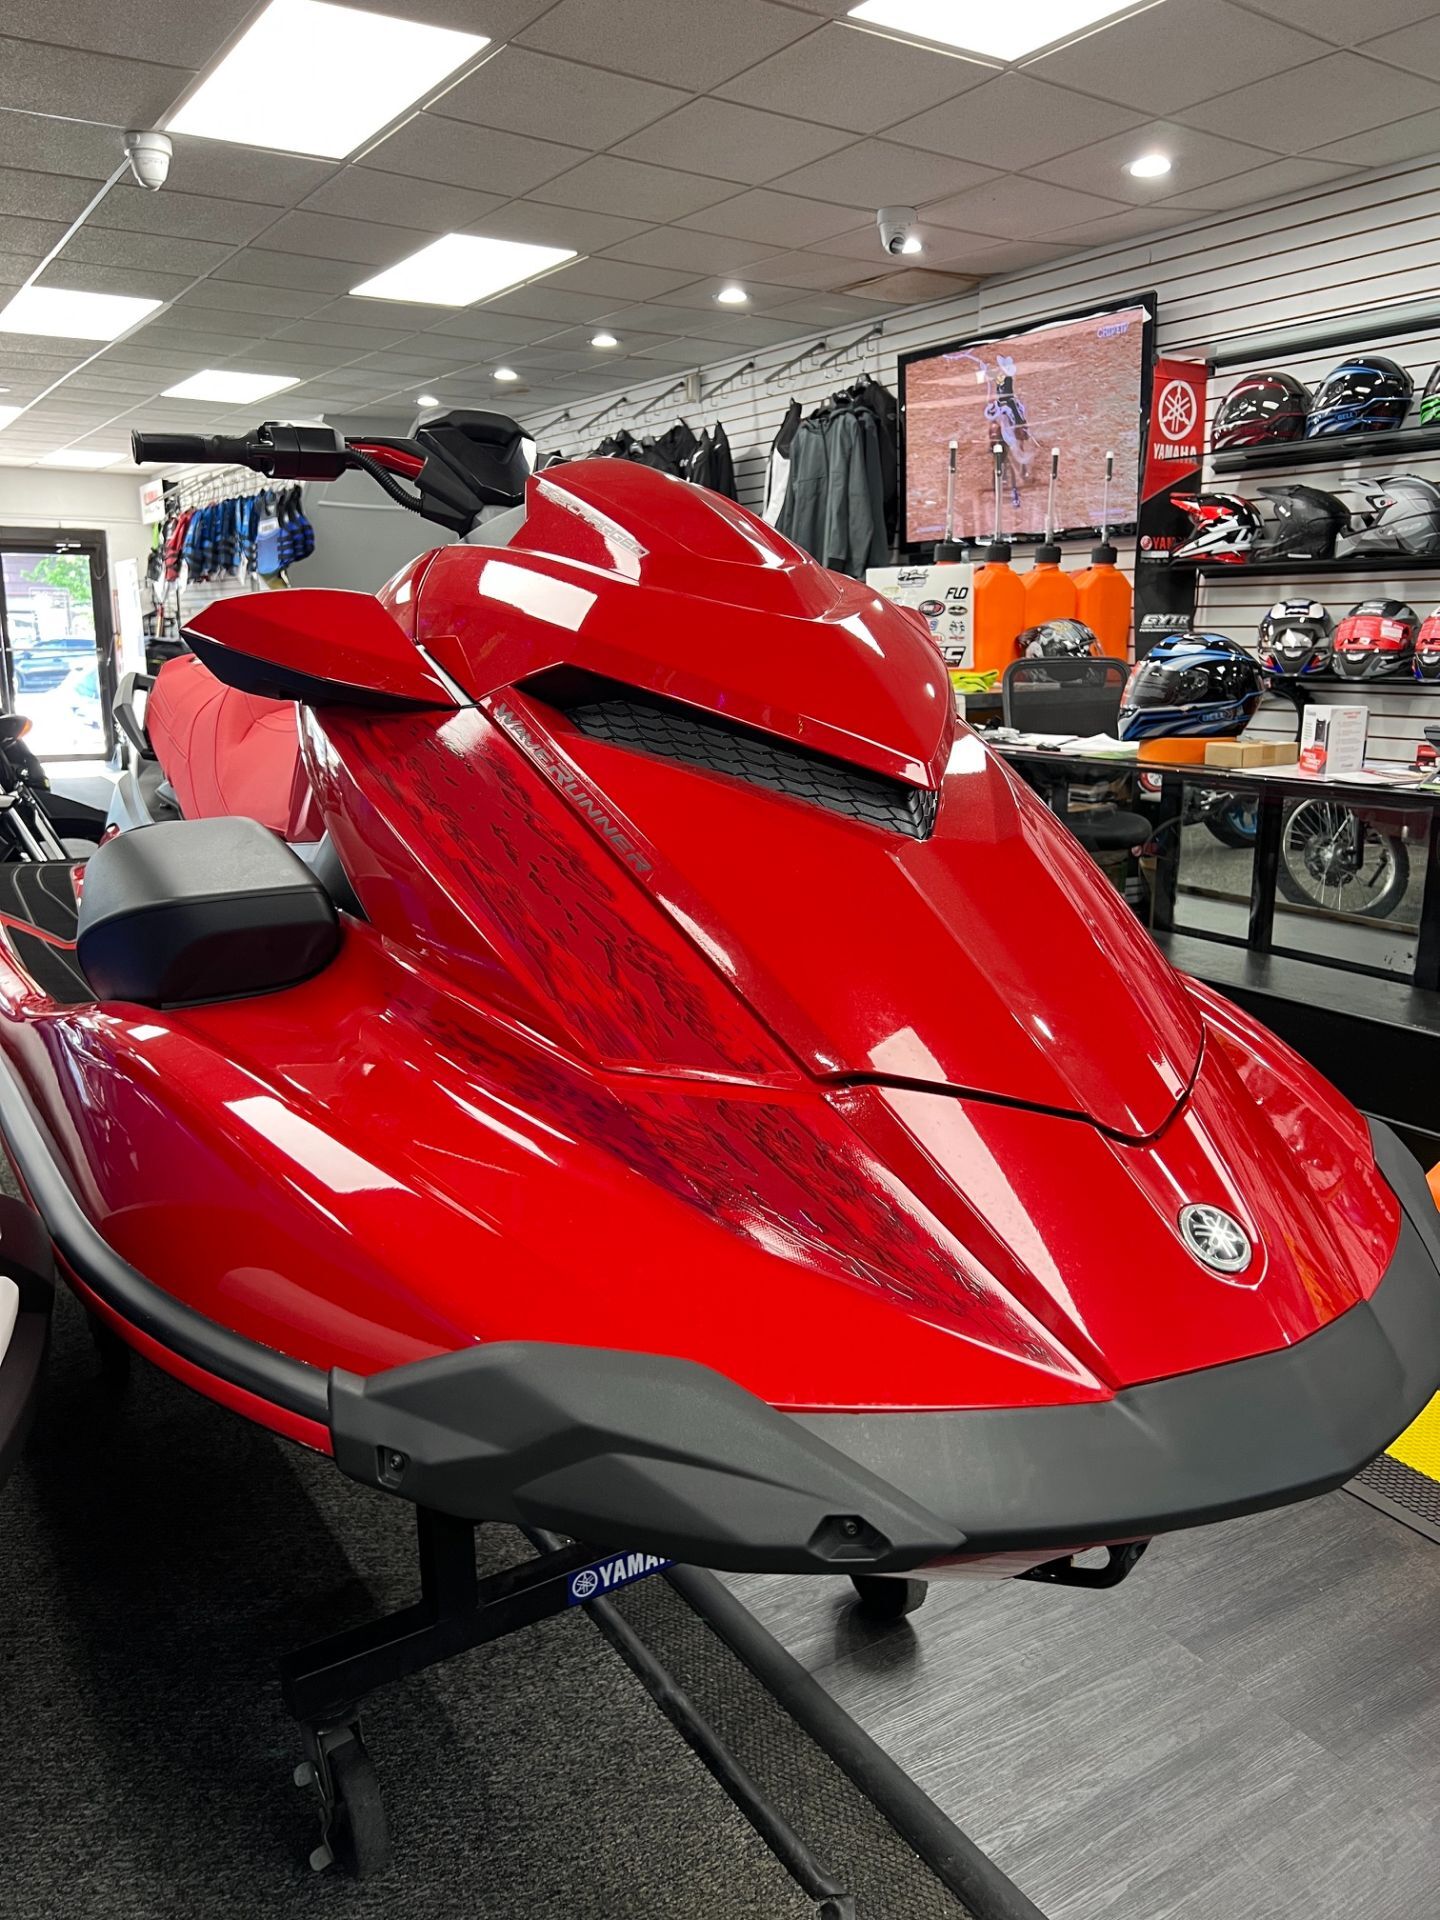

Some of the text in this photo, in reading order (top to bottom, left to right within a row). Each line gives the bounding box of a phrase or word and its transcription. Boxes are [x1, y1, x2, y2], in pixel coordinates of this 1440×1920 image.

[1154, 442, 1197, 461] YAMAHA
[945, 587, 969, 600] FLO
[493, 703, 652, 871] WAVERUNNER
[599, 1552, 671, 1588] YAMA
